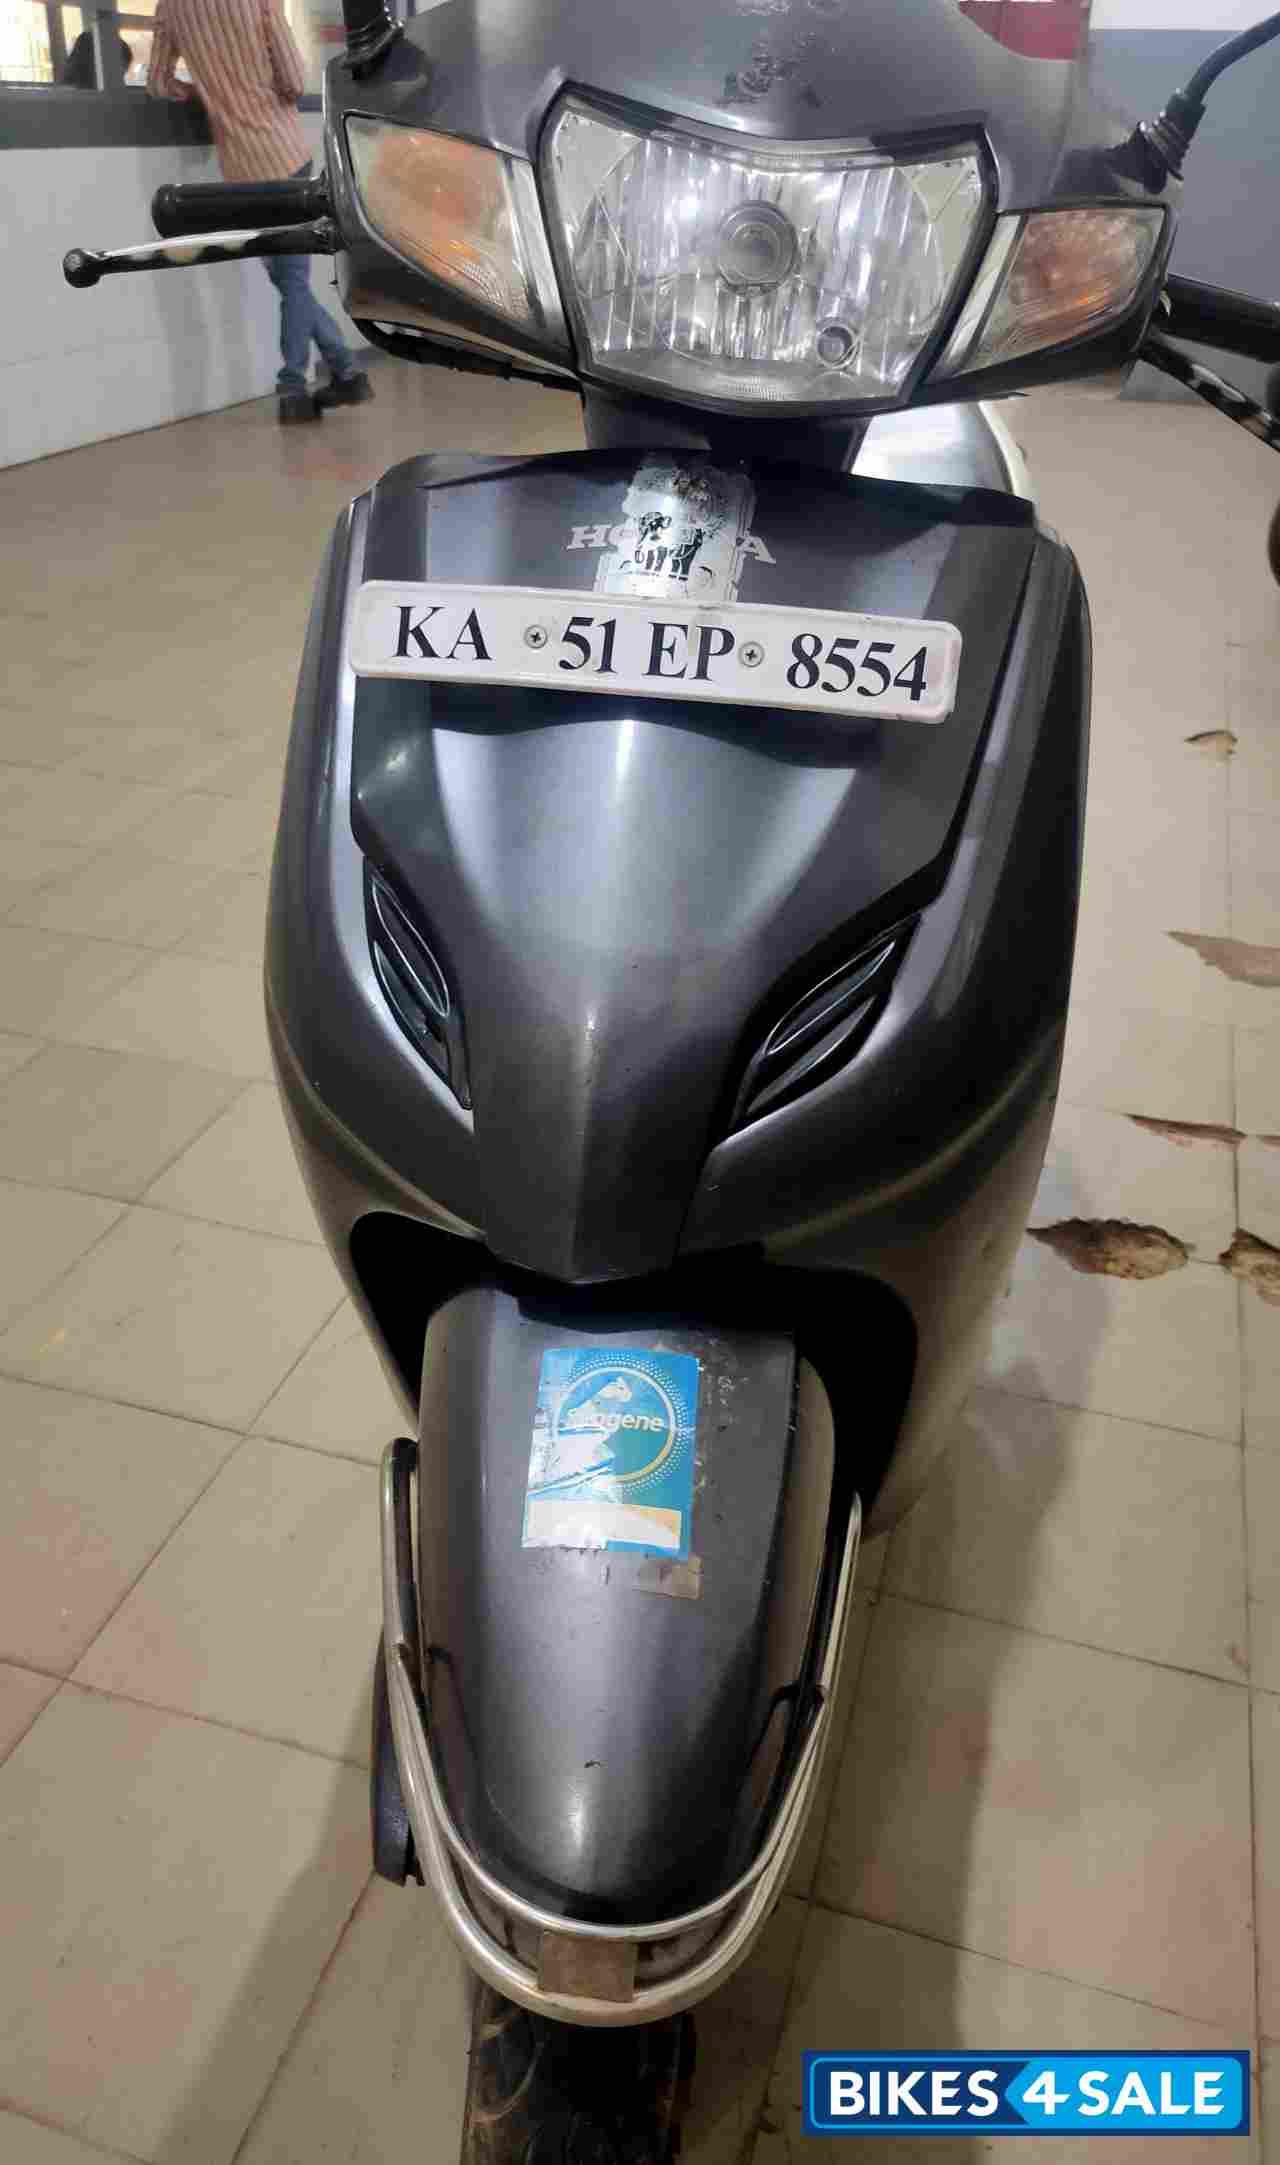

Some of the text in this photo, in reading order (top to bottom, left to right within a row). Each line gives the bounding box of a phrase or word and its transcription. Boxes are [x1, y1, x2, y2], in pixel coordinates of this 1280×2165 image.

[391, 605, 929, 702] KA 51 EP 8554
